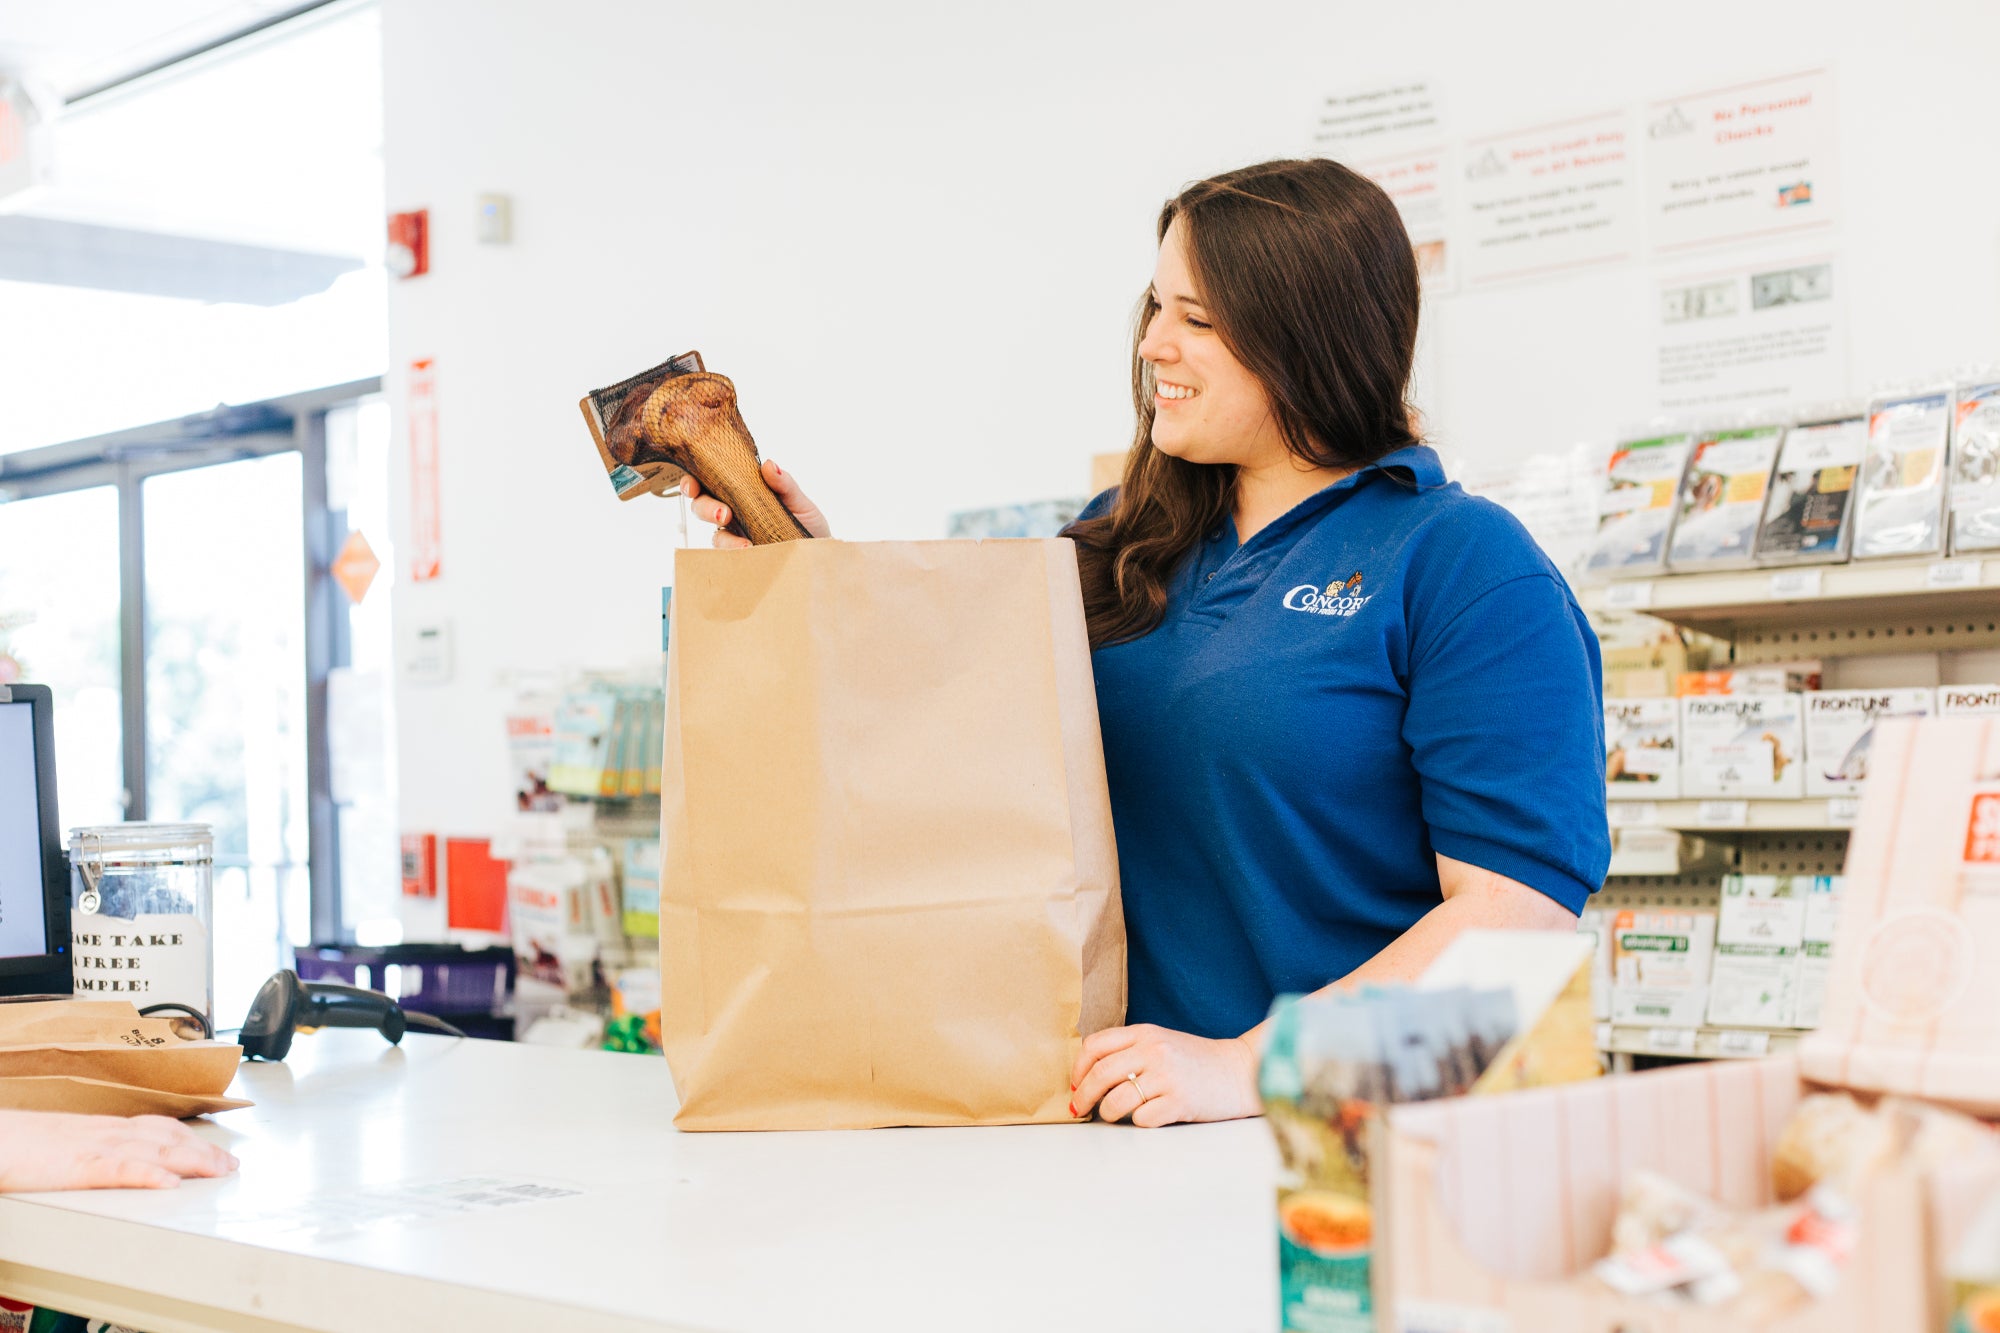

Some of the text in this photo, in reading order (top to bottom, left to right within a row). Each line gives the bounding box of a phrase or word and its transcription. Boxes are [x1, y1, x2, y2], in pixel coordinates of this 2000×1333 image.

[1713, 94, 1813, 122] No Personal
[1715, 126, 1775, 144] Checks
[1688, 701, 1763, 719] FRONTLINE
[1810, 694, 1894, 712] FRONTLINE
[109, 932, 183, 947] TAKE
[82, 956, 141, 969] FREE
